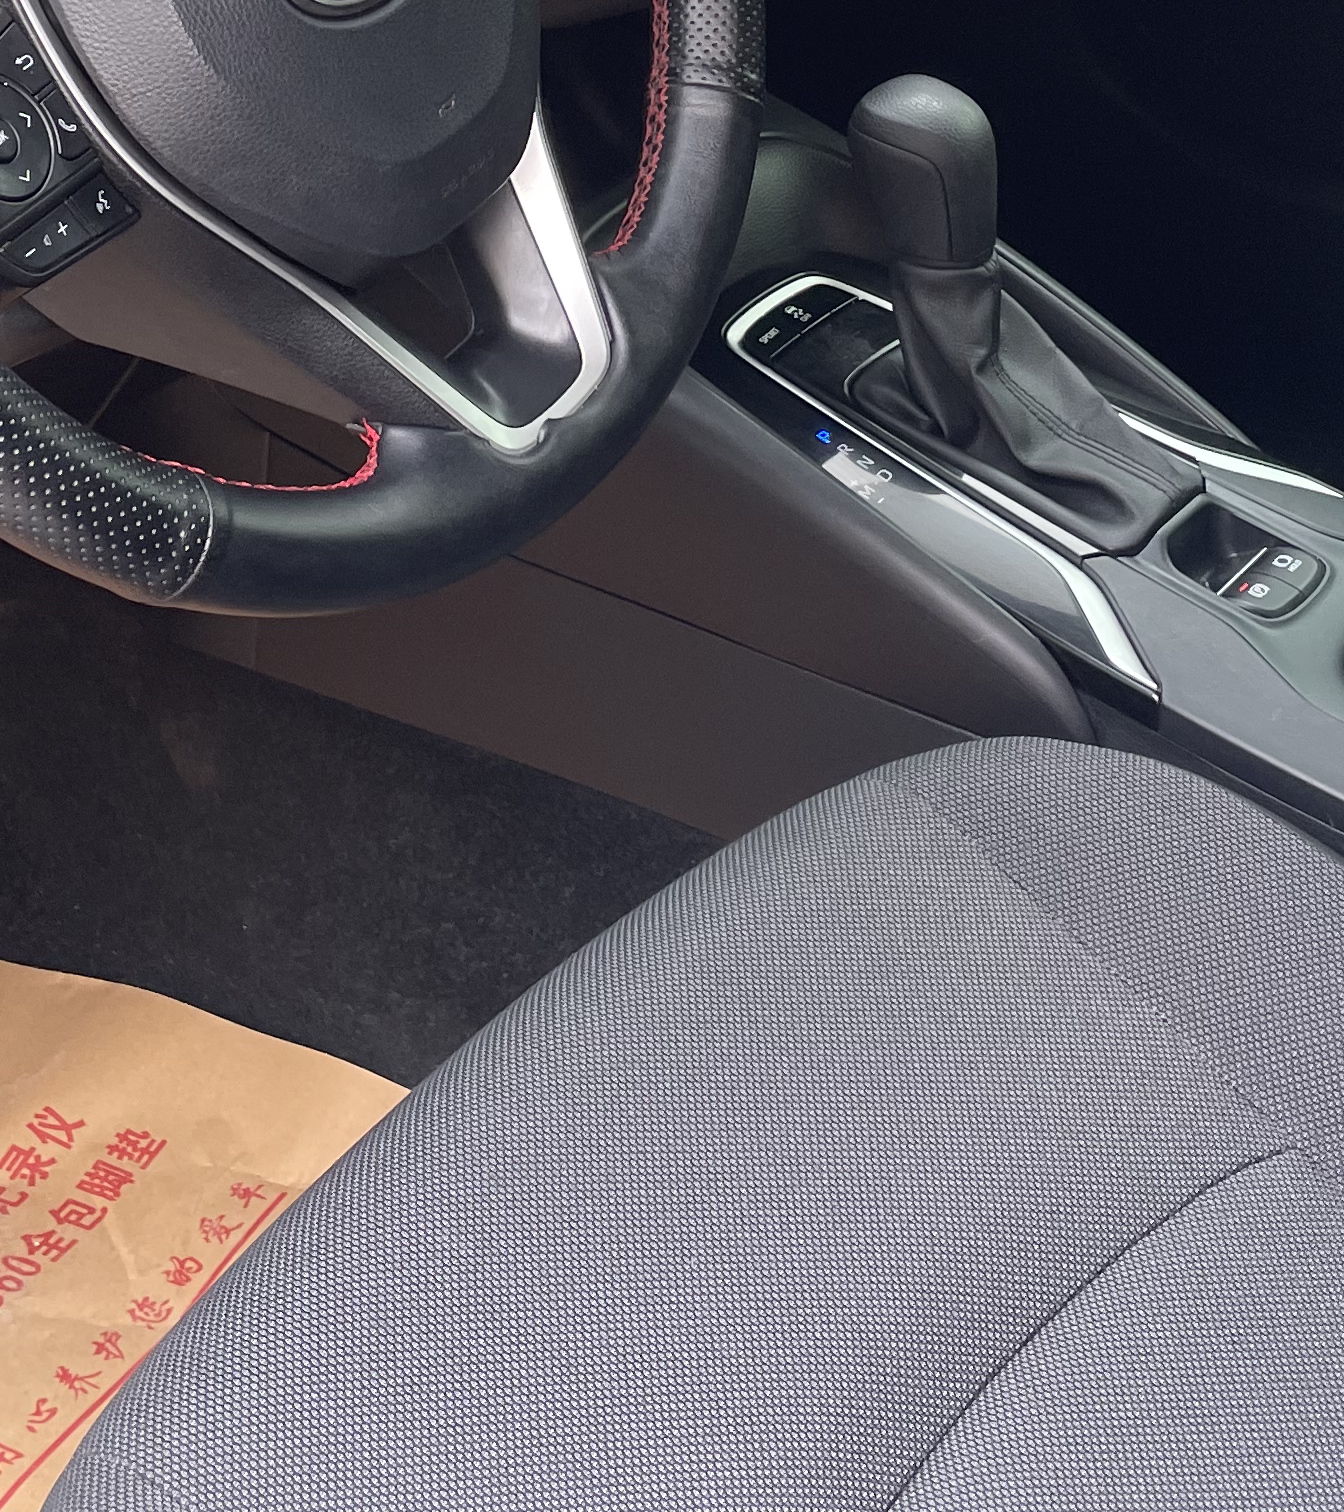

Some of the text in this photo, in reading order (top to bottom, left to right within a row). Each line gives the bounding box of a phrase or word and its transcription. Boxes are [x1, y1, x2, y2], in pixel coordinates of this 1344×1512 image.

[836, 443, 854, 456] R
[856, 454, 875, 469] N
[876, 469, 893, 483] D
[857, 484, 876, 500] M
